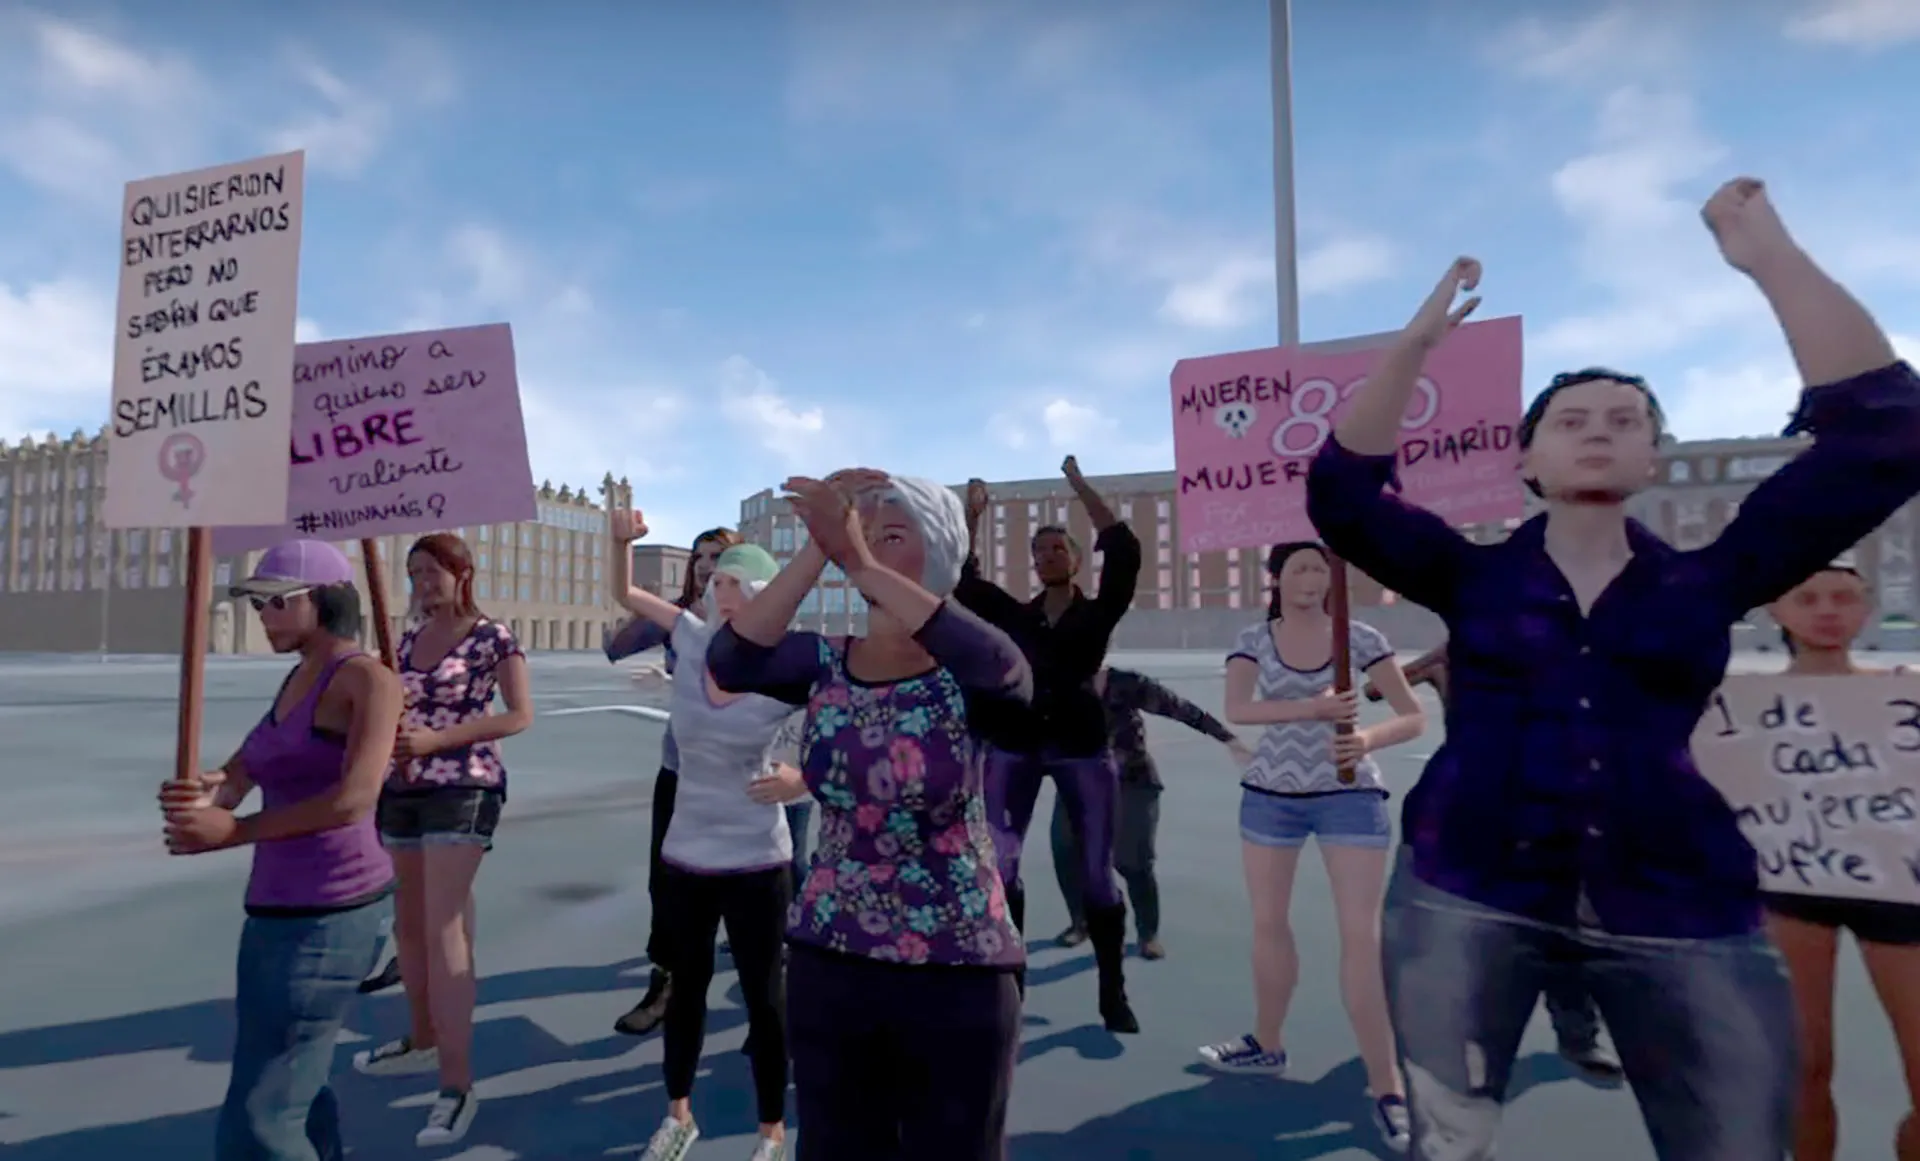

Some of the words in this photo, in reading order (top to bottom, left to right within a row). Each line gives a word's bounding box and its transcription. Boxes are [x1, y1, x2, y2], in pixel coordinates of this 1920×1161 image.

[131, 164, 285, 226] QUISIERON
[125, 201, 290, 267] ENTERRARNOS
[144, 263, 193, 298] PERO
[207, 257, 239, 286] NO
[208, 290, 259, 322] QUE
[293, 344, 407, 384] amino
[427, 340, 454, 359] a
[422, 370, 487, 395] ser
[115, 380, 268, 438] SEMILLAS
[1180, 370, 1292, 414] MUEREN
[290, 408, 424, 465] LIBRE
[329, 447, 464, 494] valiente
[1713, 692, 1740, 737] 1
[1760, 693, 1817, 730] de
[1760, 840, 1877, 888] ufre
